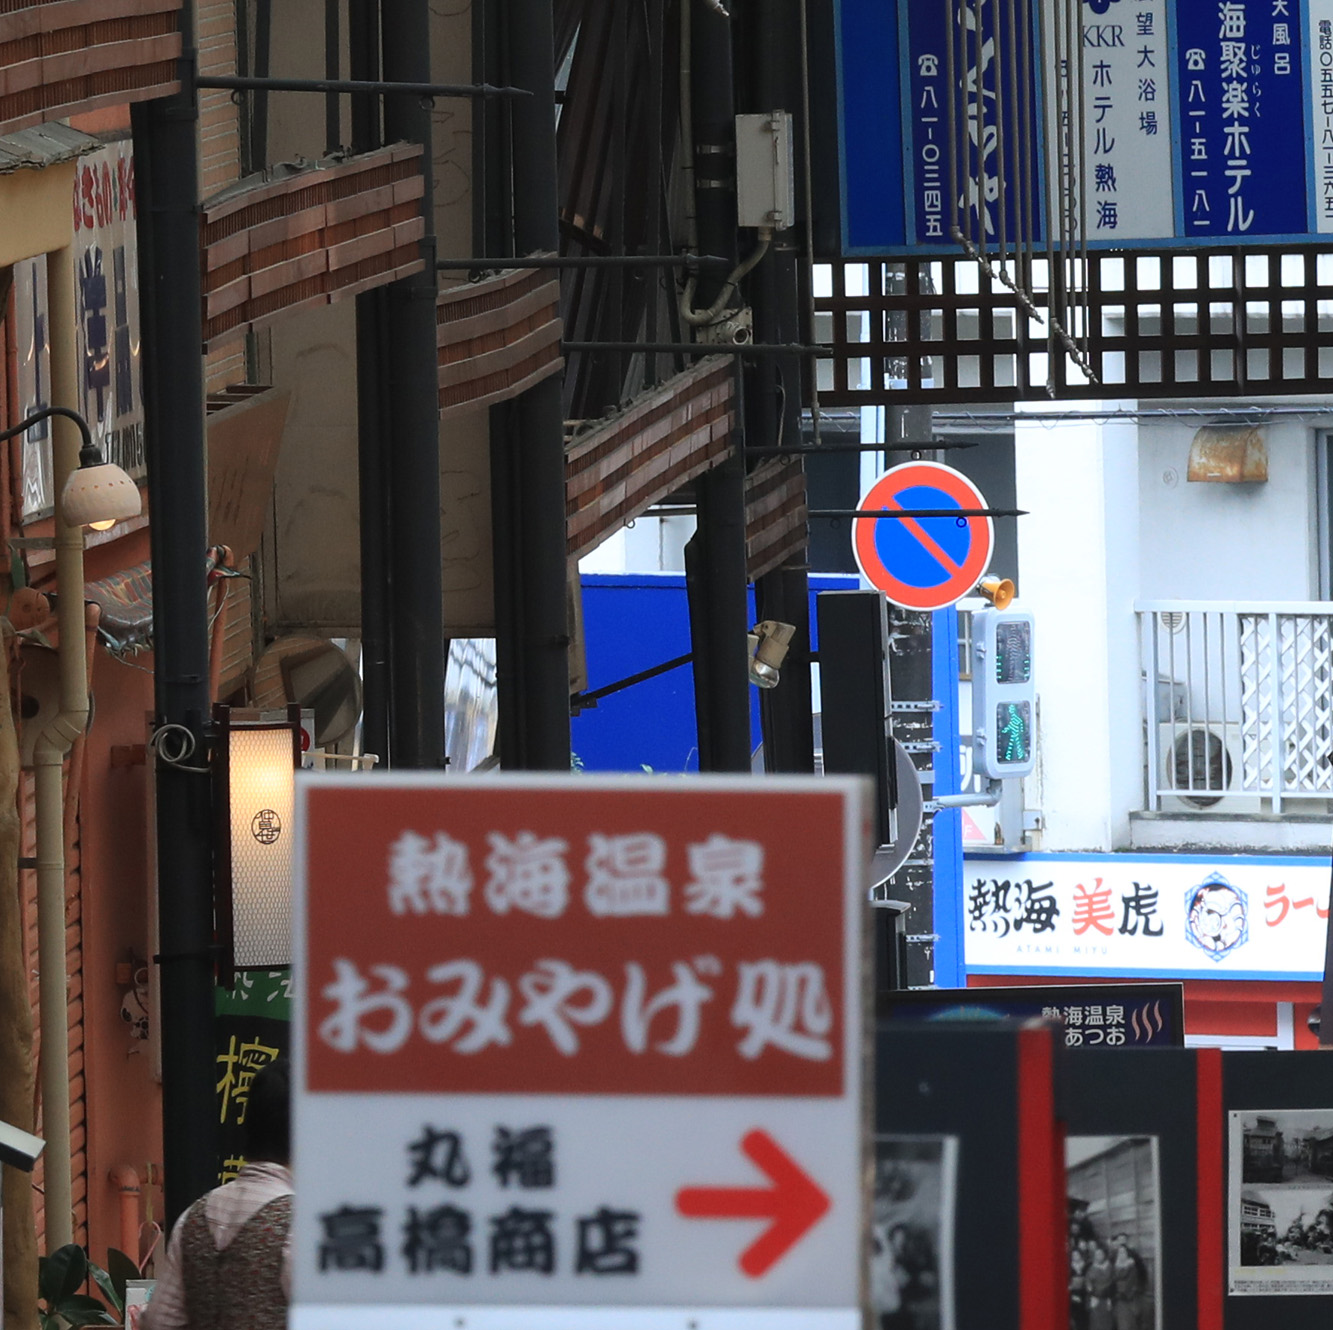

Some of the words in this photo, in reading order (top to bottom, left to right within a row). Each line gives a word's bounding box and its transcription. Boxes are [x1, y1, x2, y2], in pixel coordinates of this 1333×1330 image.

[1135, 0, 1158, 136] 望大浴場
[1250, 44, 1261, 118] じゅらく
[1092, 60, 1118, 230] ホテル熱海
[388, 829, 766, 919] 熱海温泉
[1072, 877, 1164, 938] 美虎
[318, 956, 834, 1062] おみやげ処
[1065, 1026, 1126, 1047] あつお
[408, 1125, 557, 1192] 丸福
